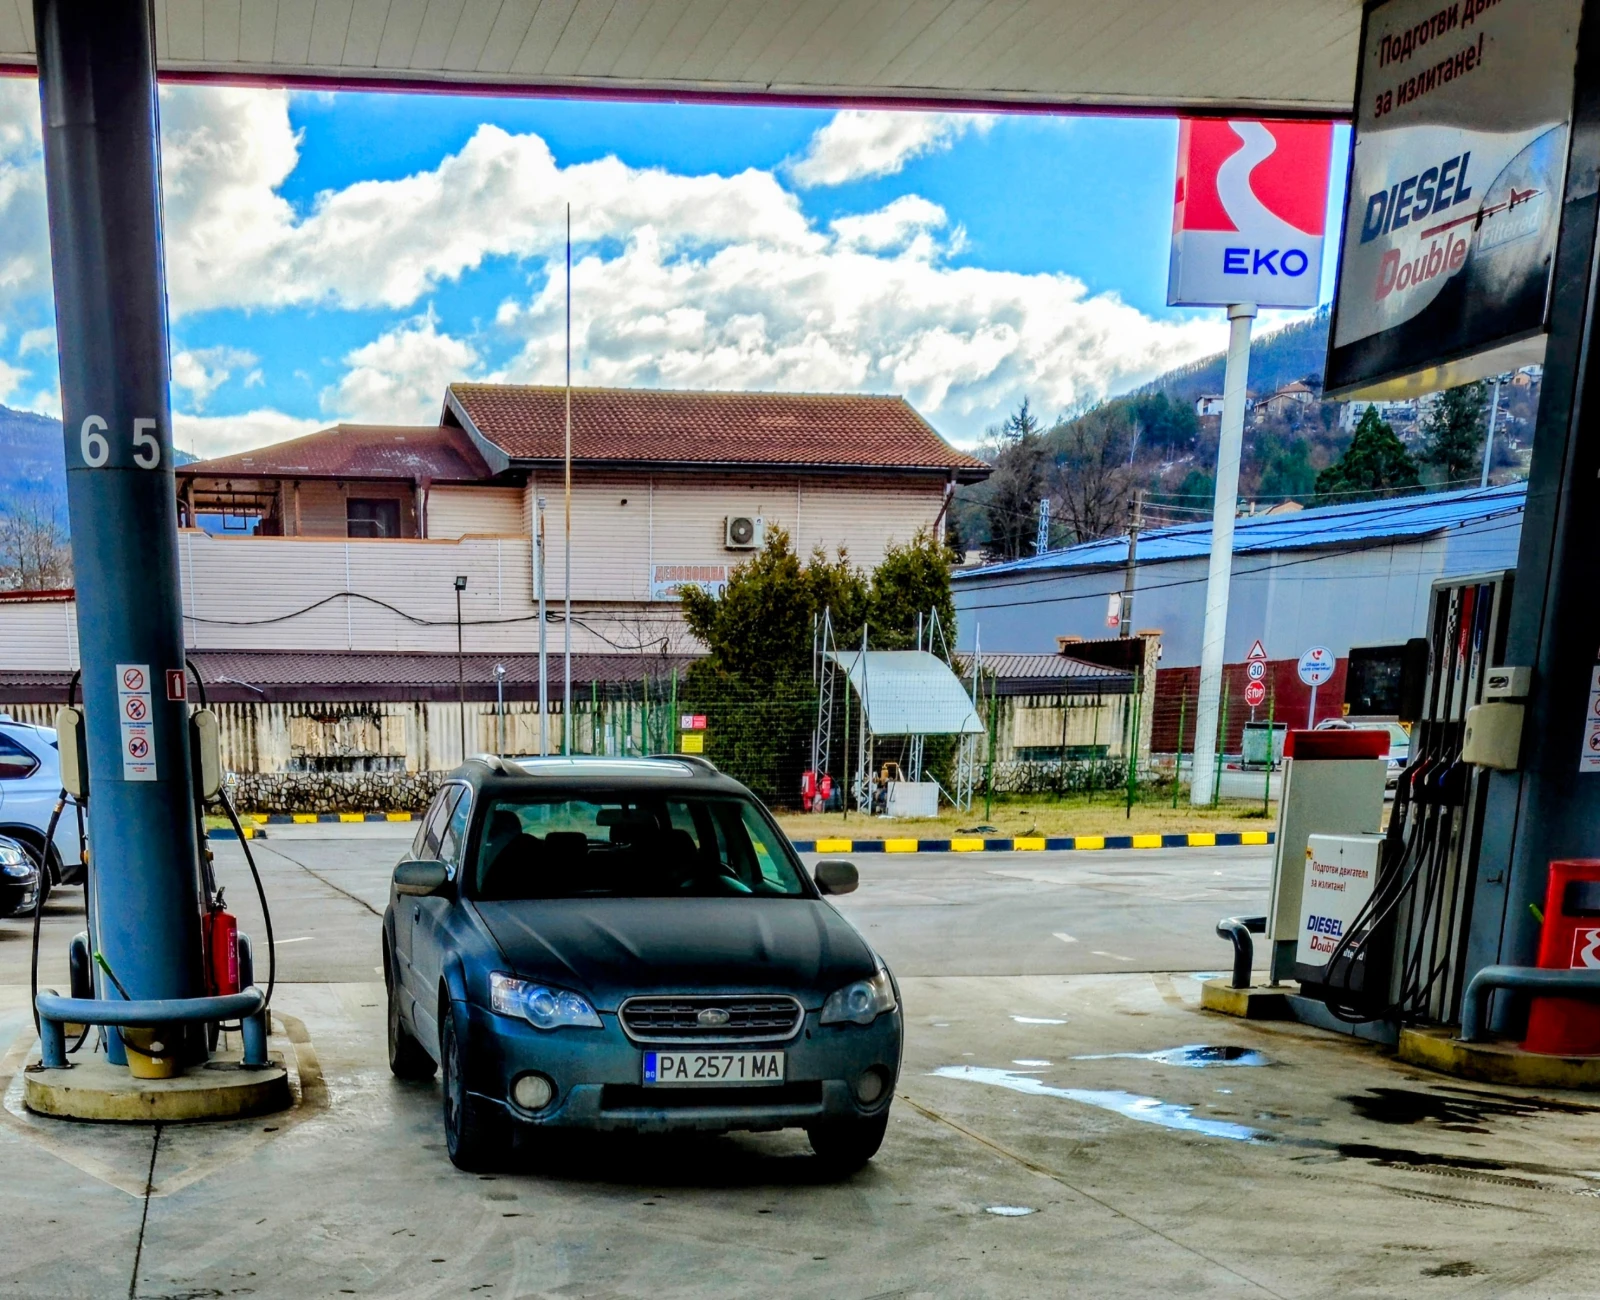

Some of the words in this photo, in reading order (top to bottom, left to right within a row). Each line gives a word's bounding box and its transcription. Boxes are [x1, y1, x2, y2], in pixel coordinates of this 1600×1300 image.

[1379, 3, 1459, 69] Подготви
[1374, 90, 1393, 119] за
[1396, 32, 1484, 108] излитане!
[1360, 151, 1473, 245] DIESEL
[1223, 248, 1309, 277] EKO
[1375, 231, 1467, 301] Double
[1480, 205, 1541, 248] Filtered
[80, 414, 109, 468] 6
[132, 417, 160, 470] 5
[1251, 665, 1263, 676] 30
[1247, 687, 1264, 699] STOP
[1312, 861, 1339, 874] Подготви
[1338, 867, 1369, 879] двигателя
[1310, 879, 1318, 888] за
[1318, 880, 1347, 892] излитане!
[1307, 915, 1343, 937] DIESEL
[645, 1070, 655, 1079] BG
[660, 1056, 688, 1078] PA
[693, 1056, 745, 1078] 2571
[751, 1055, 779, 1078] MA
